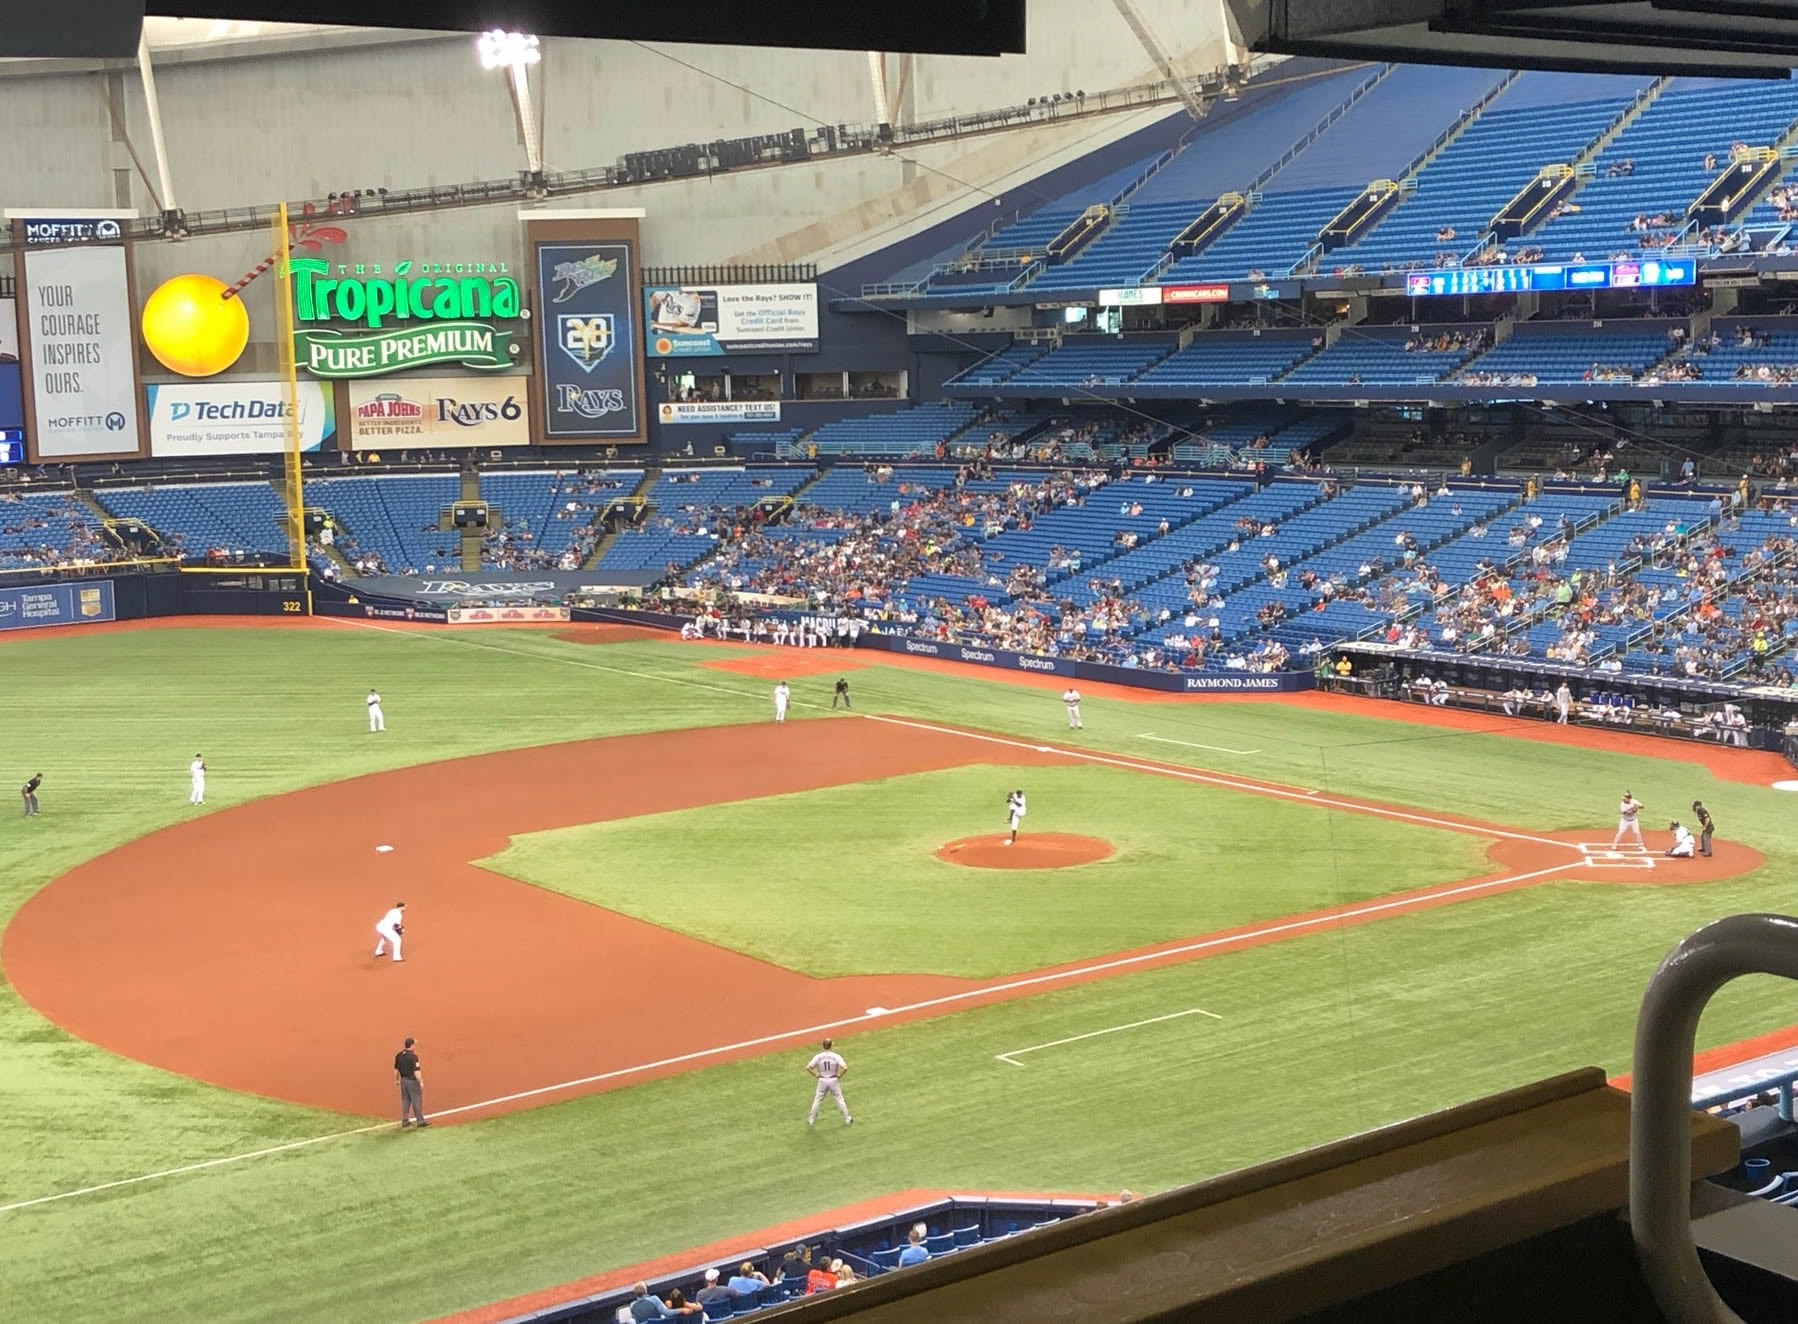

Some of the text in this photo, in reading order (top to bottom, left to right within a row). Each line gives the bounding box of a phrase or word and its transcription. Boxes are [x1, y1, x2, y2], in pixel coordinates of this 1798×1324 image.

[339, 263, 509, 274] THE ORIGINAL
[38, 285, 73, 307] YOUR
[280, 258, 520, 328] Tropicana
[41, 314, 101, 336] COURAGE
[43, 342, 101, 364] INSPIRES
[310, 331, 494, 370] PURE PREMIUM
[45, 372, 84, 394] OURS.
[195, 401, 246, 420] Tech
[358, 402, 385, 417] PAPA
[500, 396, 522, 420] 6
[48, 416, 103, 428] MOFFITT
[166, 430, 304, 443] Proudly Supports Tampa By
[360, 427, 393, 435] BETTER
[21, 594, 52, 602] Tampa
[22, 600, 58, 610] General
[23, 608, 60, 618] Hospital
[282, 601, 301, 612] 322
[906, 640, 938, 654] Spectrum
[961, 648, 994, 662] Spectrum
[1018, 655, 1055, 670] Spectrum
[1187, 678, 1278, 689] RAYMOND JAMES
[824, 1060, 830, 1072] 11
